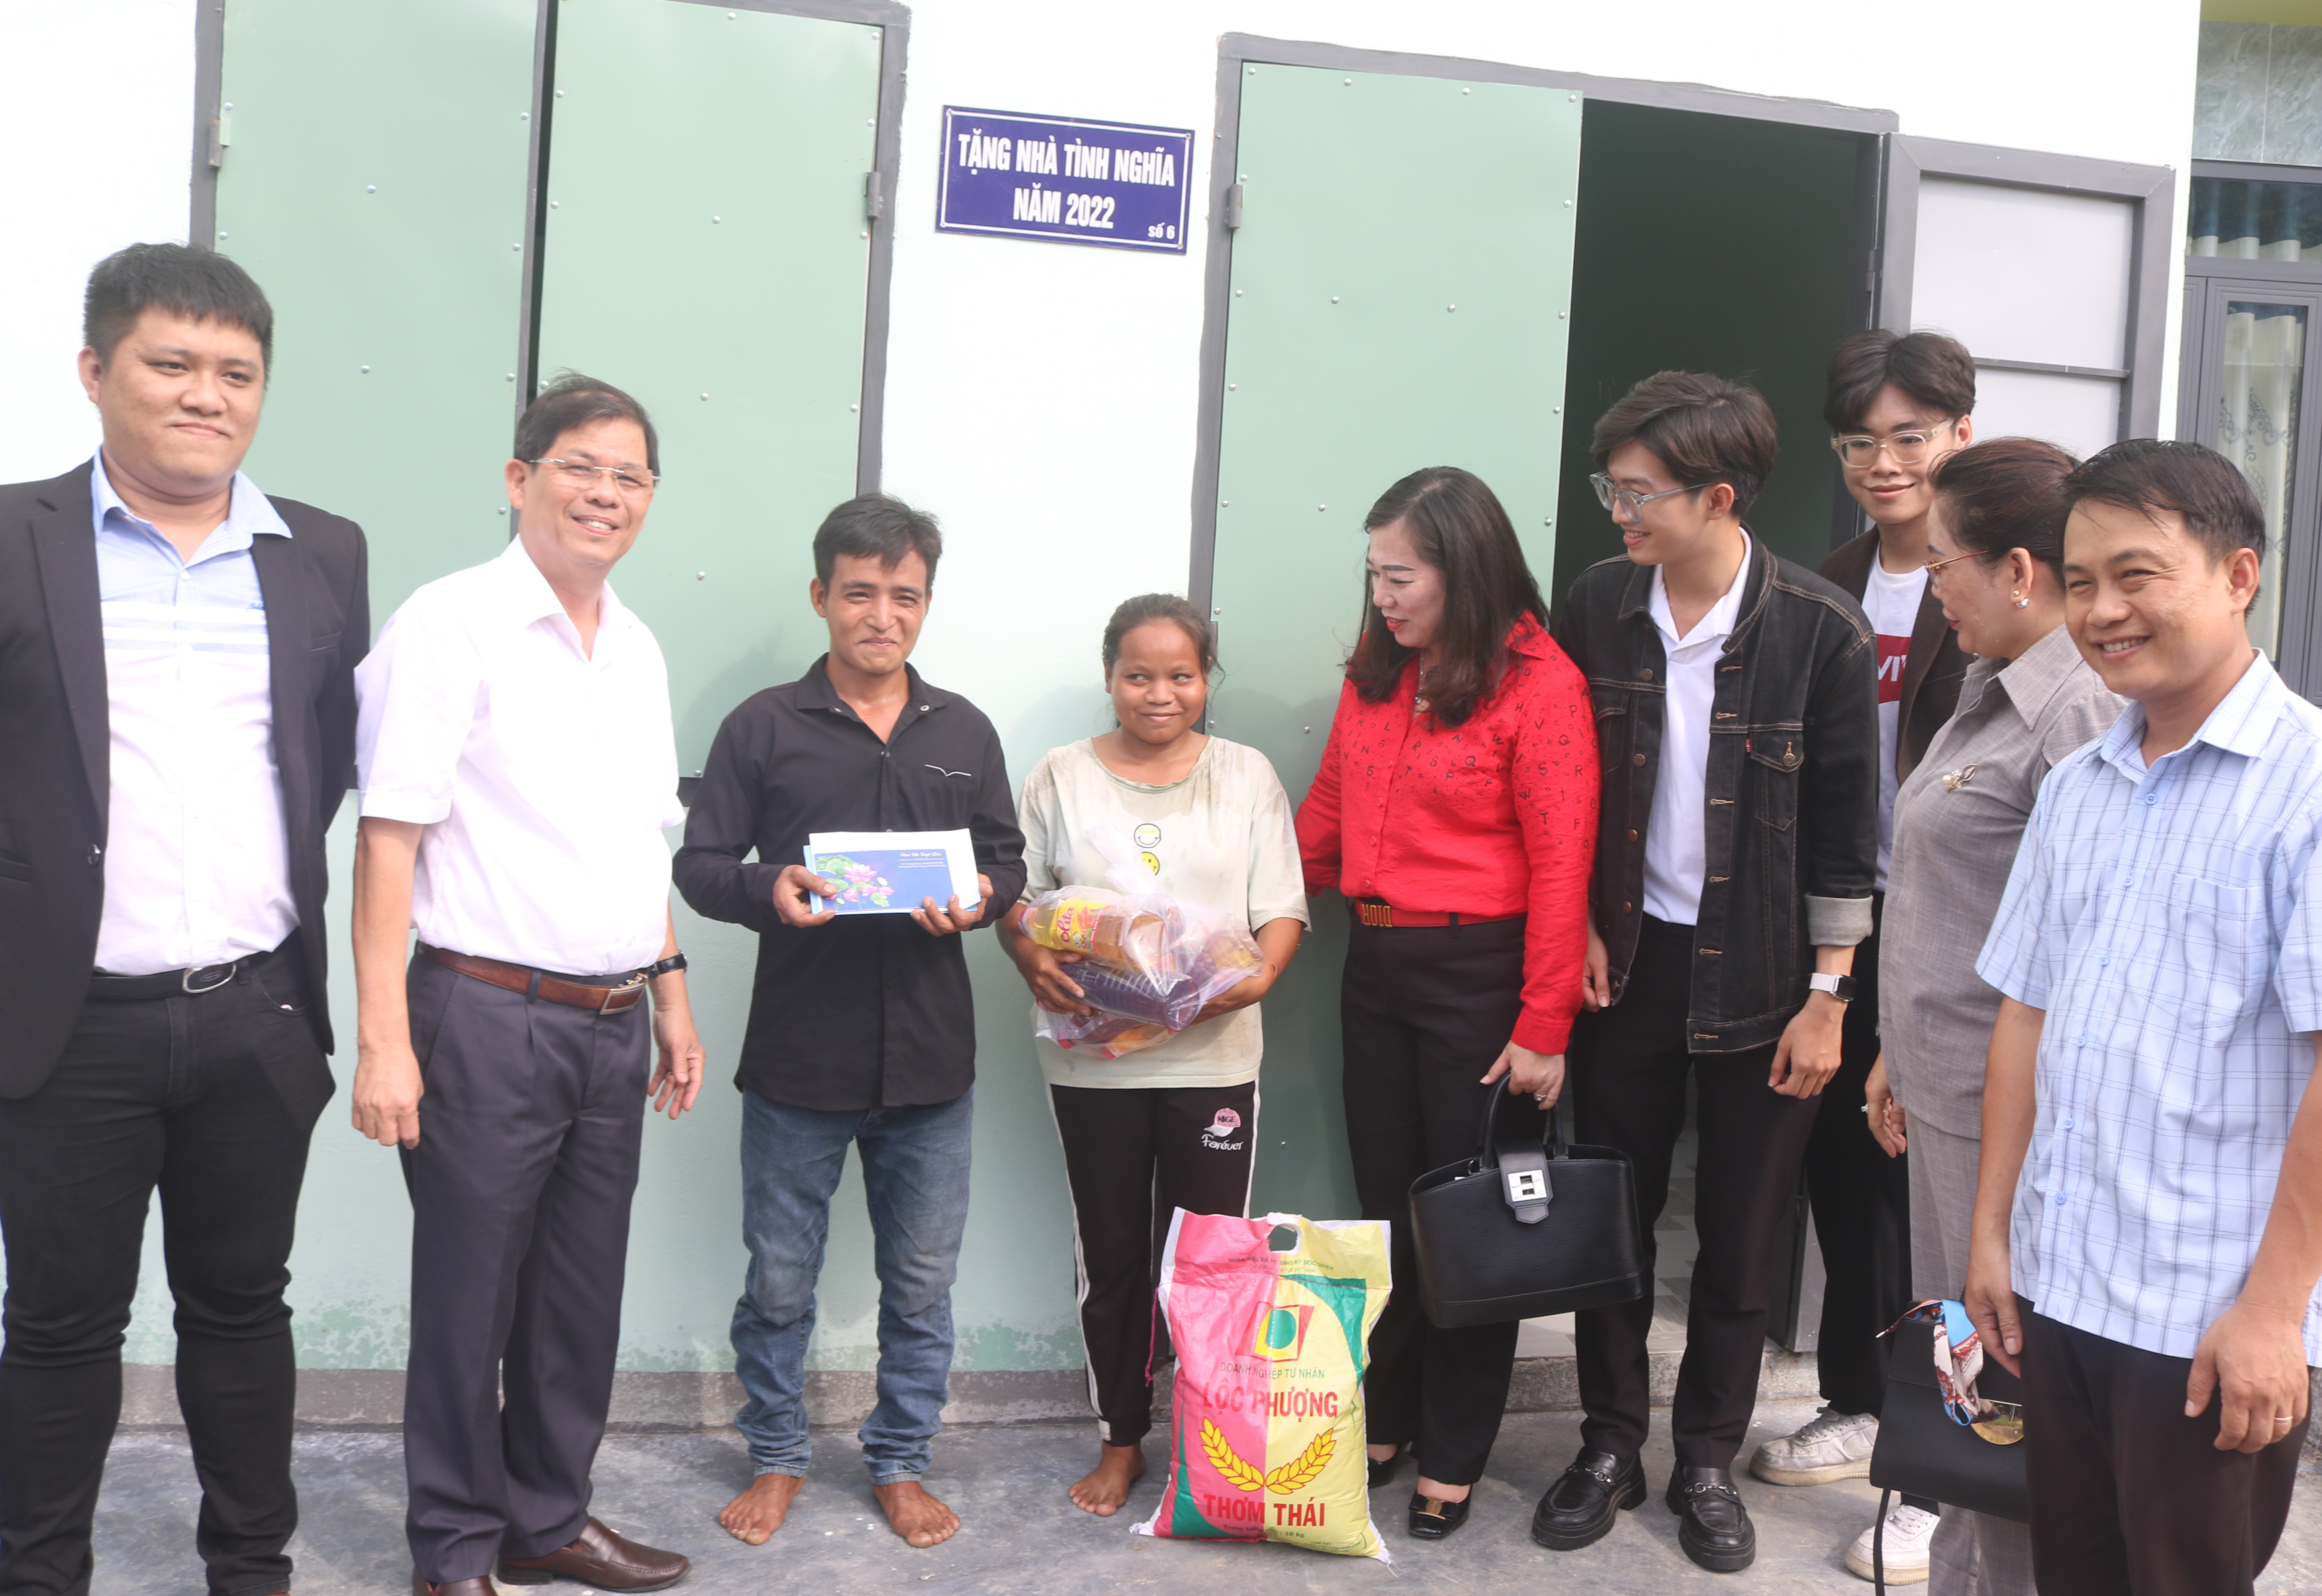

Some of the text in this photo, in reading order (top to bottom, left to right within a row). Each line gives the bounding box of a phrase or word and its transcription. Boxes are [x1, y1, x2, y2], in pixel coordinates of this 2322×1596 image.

[958, 128, 1174, 187] TẶNG NHÀ TÌNH NGHĨA
[1013, 182, 1115, 229] NĂM 2022
[1148, 222, 1175, 239] số 6
[1220, 1362, 1325, 1382] DOANH NGHỆP TƯ NHÂN
[1203, 1377, 1338, 1423] LỘC PHƯỢNG
[1203, 1493, 1325, 1527] THƠM THÁI
